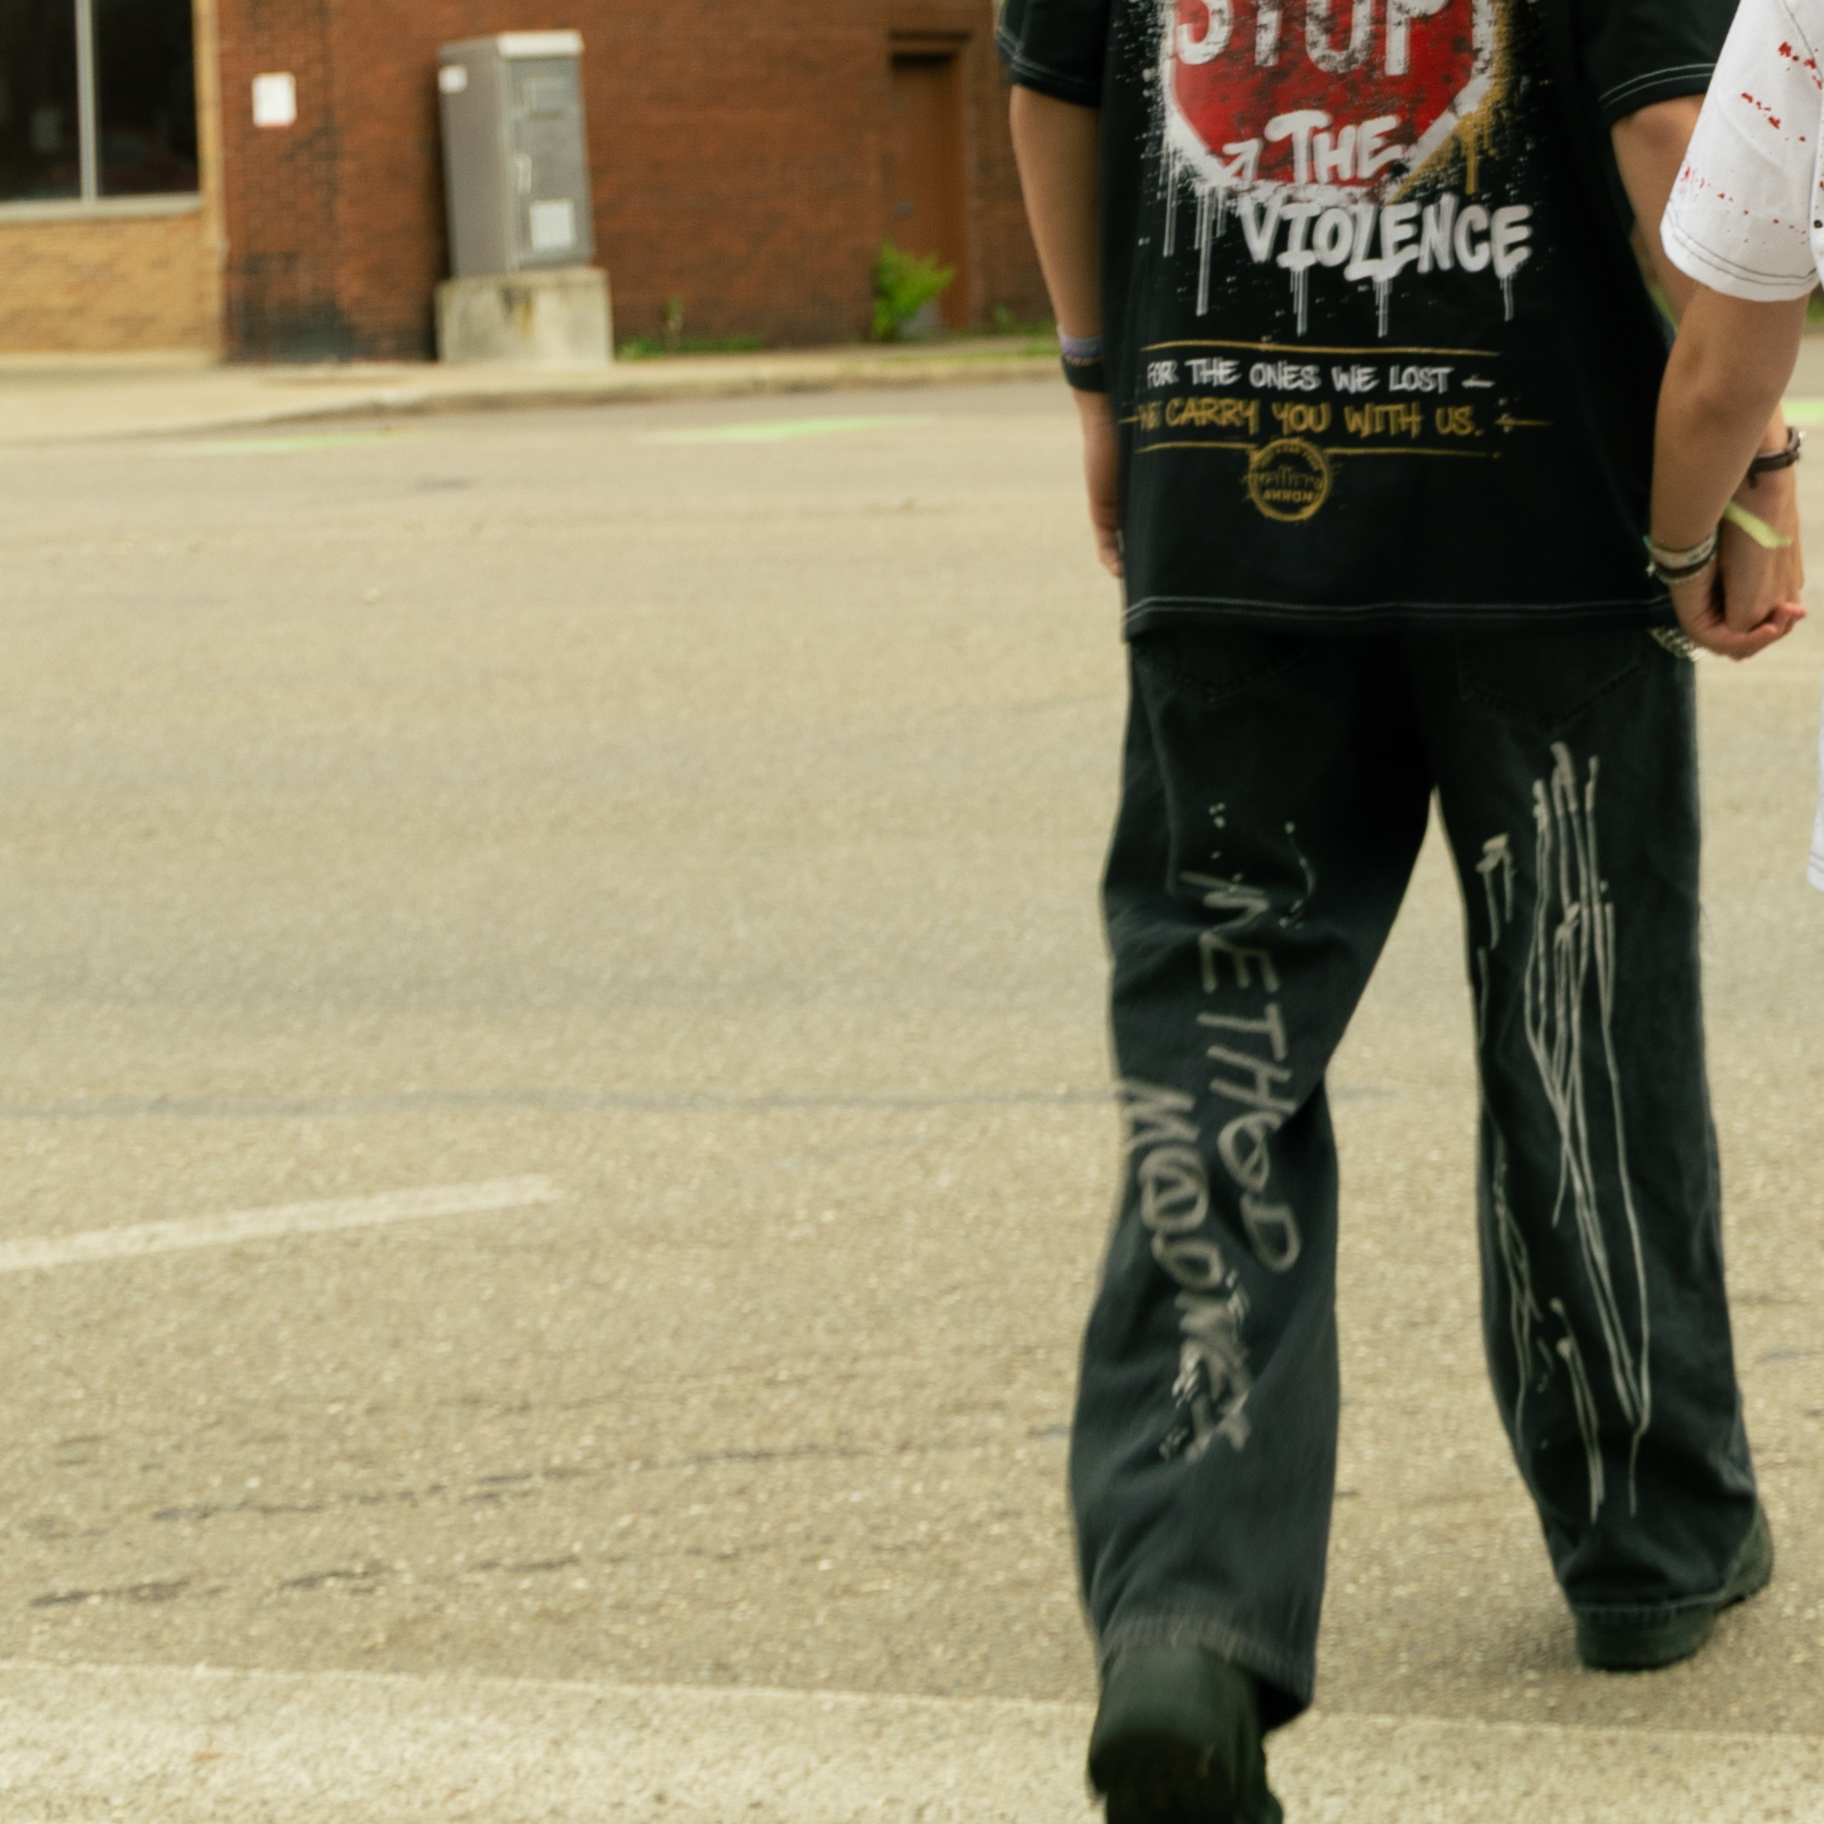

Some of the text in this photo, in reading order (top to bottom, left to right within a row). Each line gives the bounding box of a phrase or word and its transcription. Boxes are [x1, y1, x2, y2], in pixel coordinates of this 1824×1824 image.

[1265, 110, 1408, 185] THE
[1239, 193, 1533, 282] VIOLENCE
[1147, 360, 1179, 389] FOR
[1184, 355, 1243, 388] THE
[1250, 359, 1321, 392] ONES
[1331, 364, 1380, 393] WE
[1388, 365, 1455, 393] LOST
[1165, 396, 1261, 435] CARRY
[1271, 401, 1331, 436] YOU
[1344, 403, 1424, 438] WITH
[1435, 405, 1484, 437] US.
